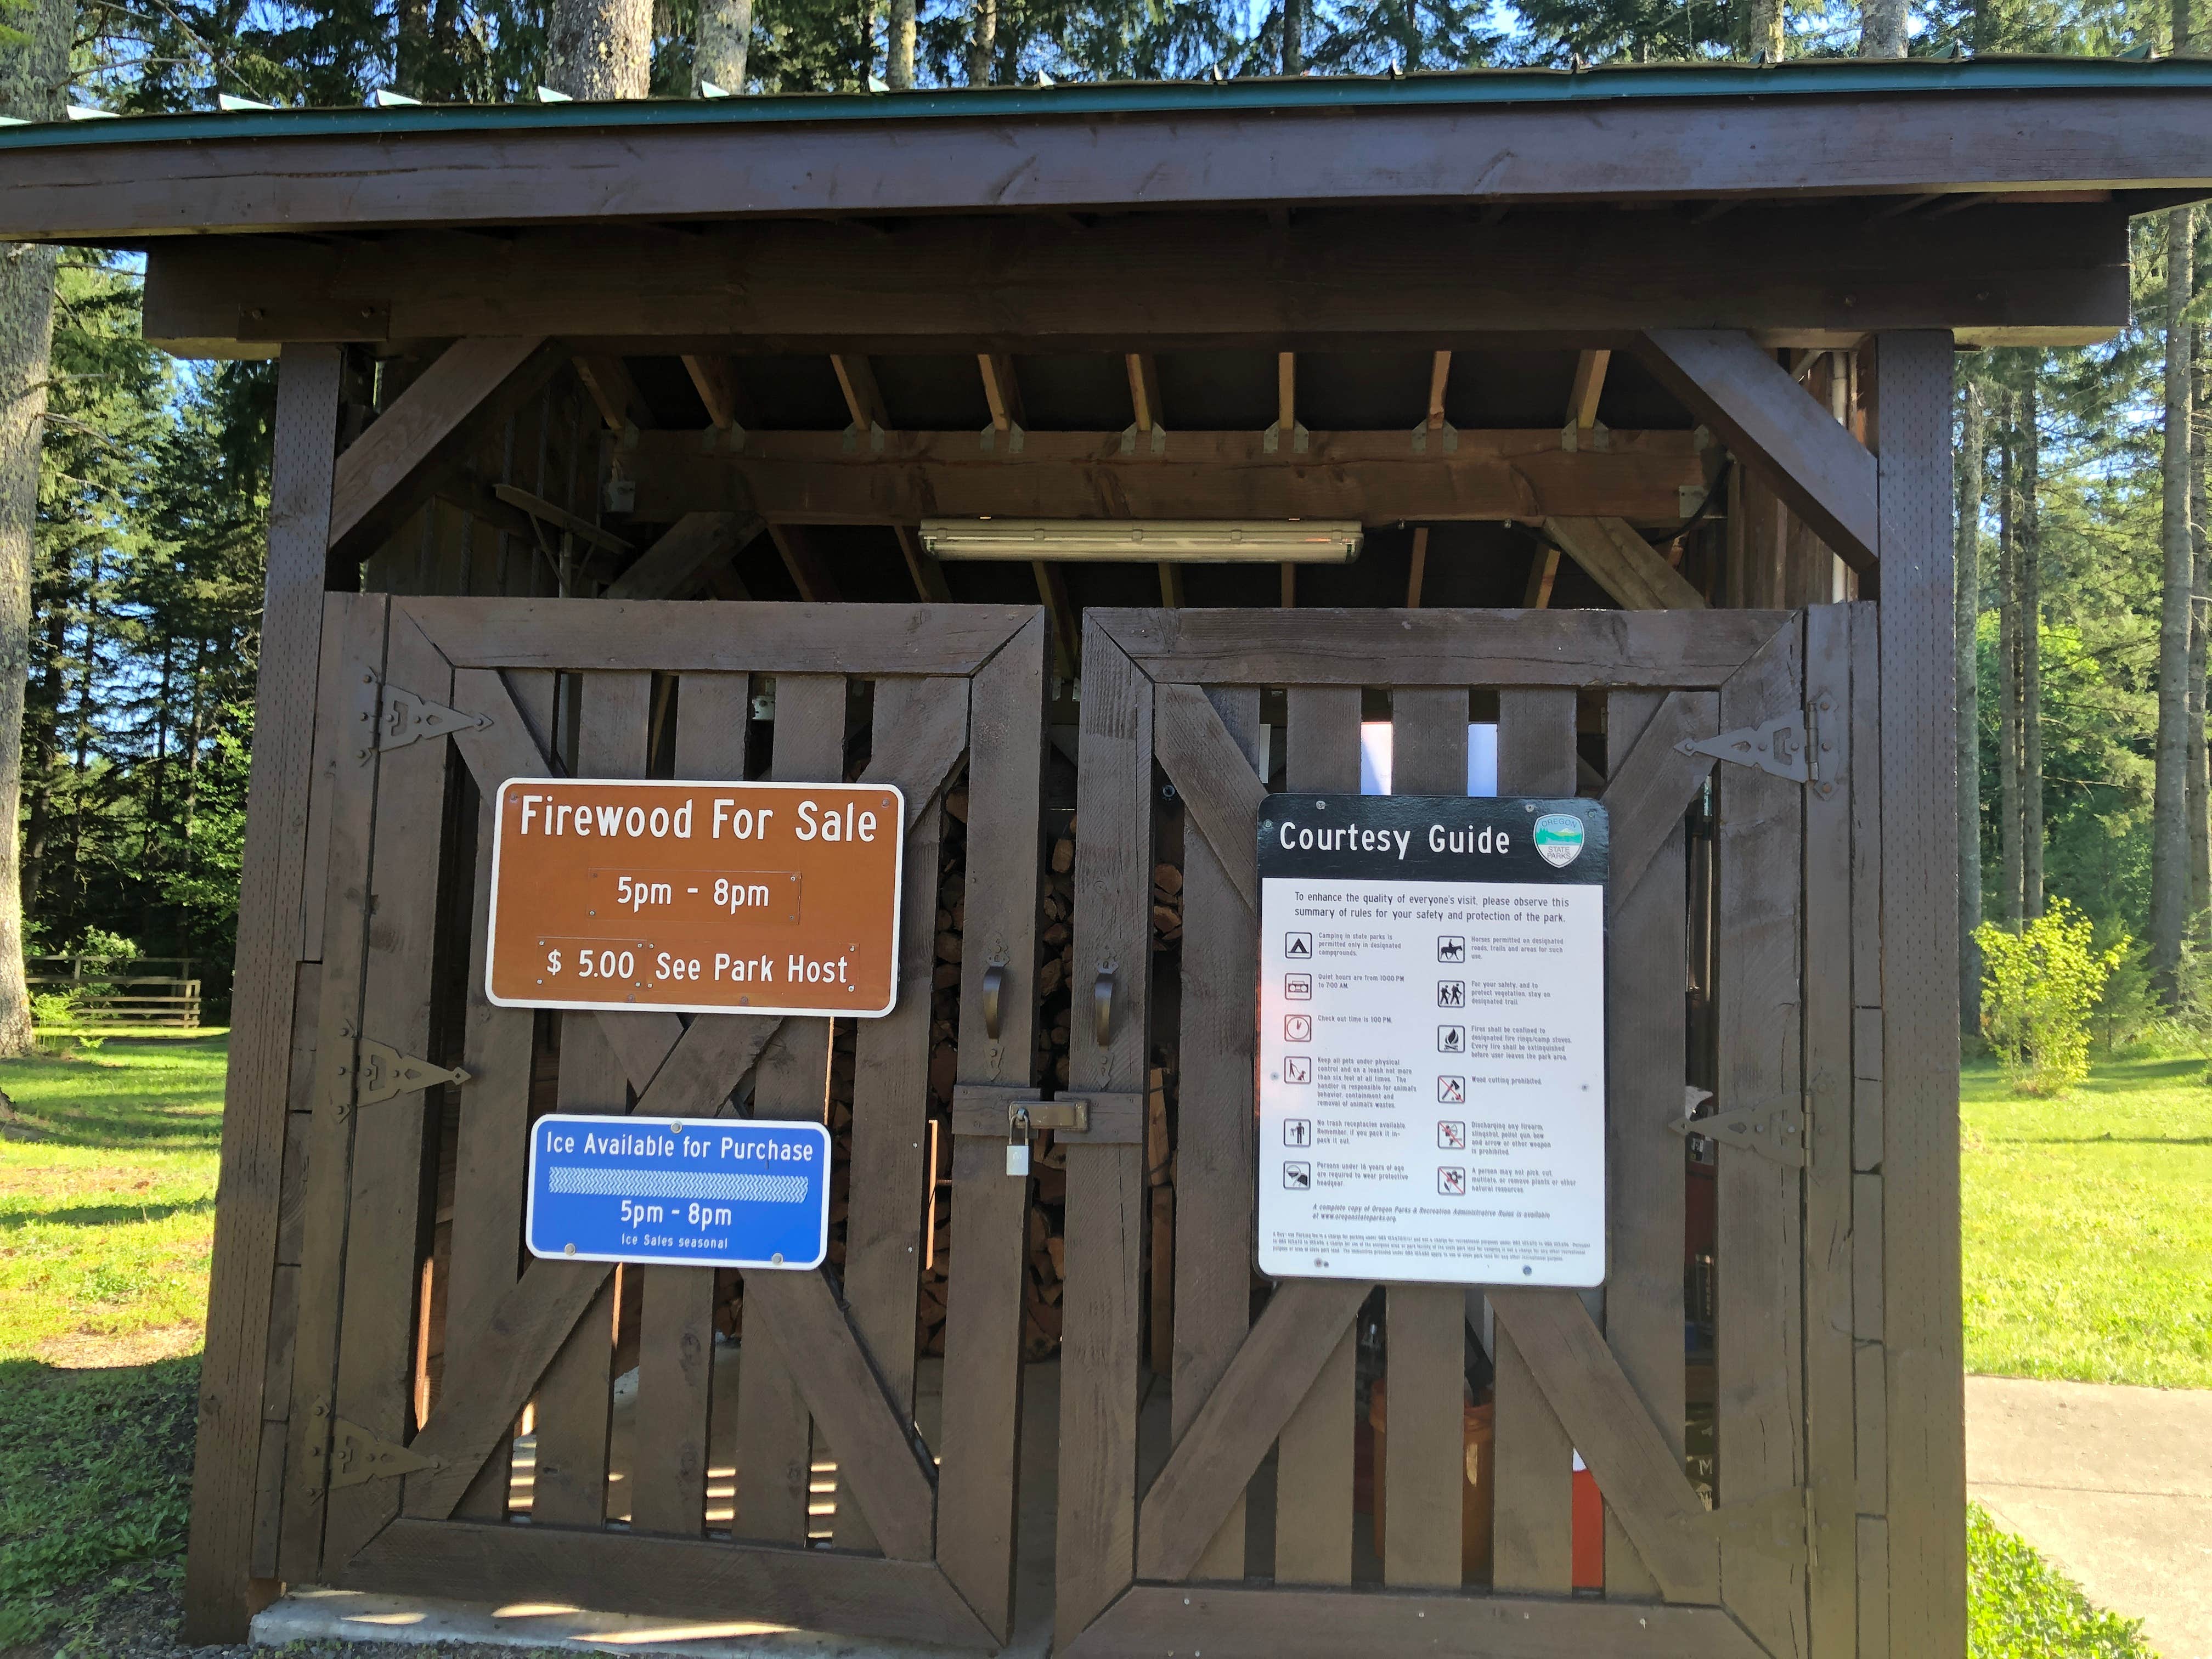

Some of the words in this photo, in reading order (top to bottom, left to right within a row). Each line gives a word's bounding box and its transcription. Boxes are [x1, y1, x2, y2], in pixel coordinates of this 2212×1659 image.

[521, 796, 692, 837] Firewood
[713, 799, 774, 839] For
[795, 802, 877, 841] Sale
[1542, 818, 1577, 828] OREGON
[1280, 822, 1411, 860] Courtesy
[1429, 825, 1510, 853] Guide
[617, 877, 672, 912] 5pm
[713, 879, 769, 913] 8pm
[1295, 891, 1304, 901] To
[1307, 893, 1342, 901] enhance
[1346, 893, 1359, 902] the
[1363, 894, 1393, 905] quality
[1397, 894, 1406, 903] of
[1409, 896, 1455, 906] everyone's
[1482, 896, 1510, 907] please
[1514, 898, 1548, 906] observe
[1552, 898, 1569, 907] this
[1295, 909, 1335, 918] summary
[1339, 907, 1347, 917] of
[1351, 909, 1372, 917] rules
[1375, 909, 1388, 917] for
[1392, 911, 1412, 921] your
[1416, 910, 1443, 922] safety
[1447, 911, 1463, 919] and
[1466, 912, 1510, 922] protection
[1514, 912, 1522, 921] of
[1526, 912, 1540, 921] the
[1544, 913, 1566, 924] park.
[1318, 932, 1343, 940] Camping
[1369, 933, 1385, 941] parks
[1492, 936, 1521, 945] permitted
[1532, 937, 1564, 946] designated
[1318, 941, 1346, 949] permitted
[1347, 941, 1361, 950] only
[1370, 941, 1401, 950] designated
[546, 950, 561, 977] $
[578, 950, 634, 978] 5.00
[656, 952, 701, 980] See
[714, 953, 774, 981] Park
[788, 955, 848, 983] Host
[1471, 989, 1493, 997] protect
[1528, 990, 1542, 998] stay
[1471, 997, 1503, 1006] designated
[1471, 1034, 1503, 1042] designated
[1471, 1042, 1488, 1051] Every
[1527, 1044, 1565, 1053] extinguished
[1317, 1057, 1331, 1065] Keep
[1342, 1057, 1354, 1065] pets
[1375, 1058, 1400, 1066] physical
[1538, 1053, 1551, 1061] park
[1488, 1077, 1509, 1085] cutting
[1348, 1084, 1381, 1092] responsible
[546, 1132, 574, 1153] Ice
[584, 1132, 674, 1156] Available
[683, 1136, 712, 1158] for
[721, 1137, 813, 1160] Purchase
[620, 1200, 663, 1229] 5pm
[688, 1203, 731, 1231] 8pm
[622, 1233, 638, 1245] Ice
[644, 1234, 673, 1246] Sales
[678, 1238, 727, 1249] seasonal
